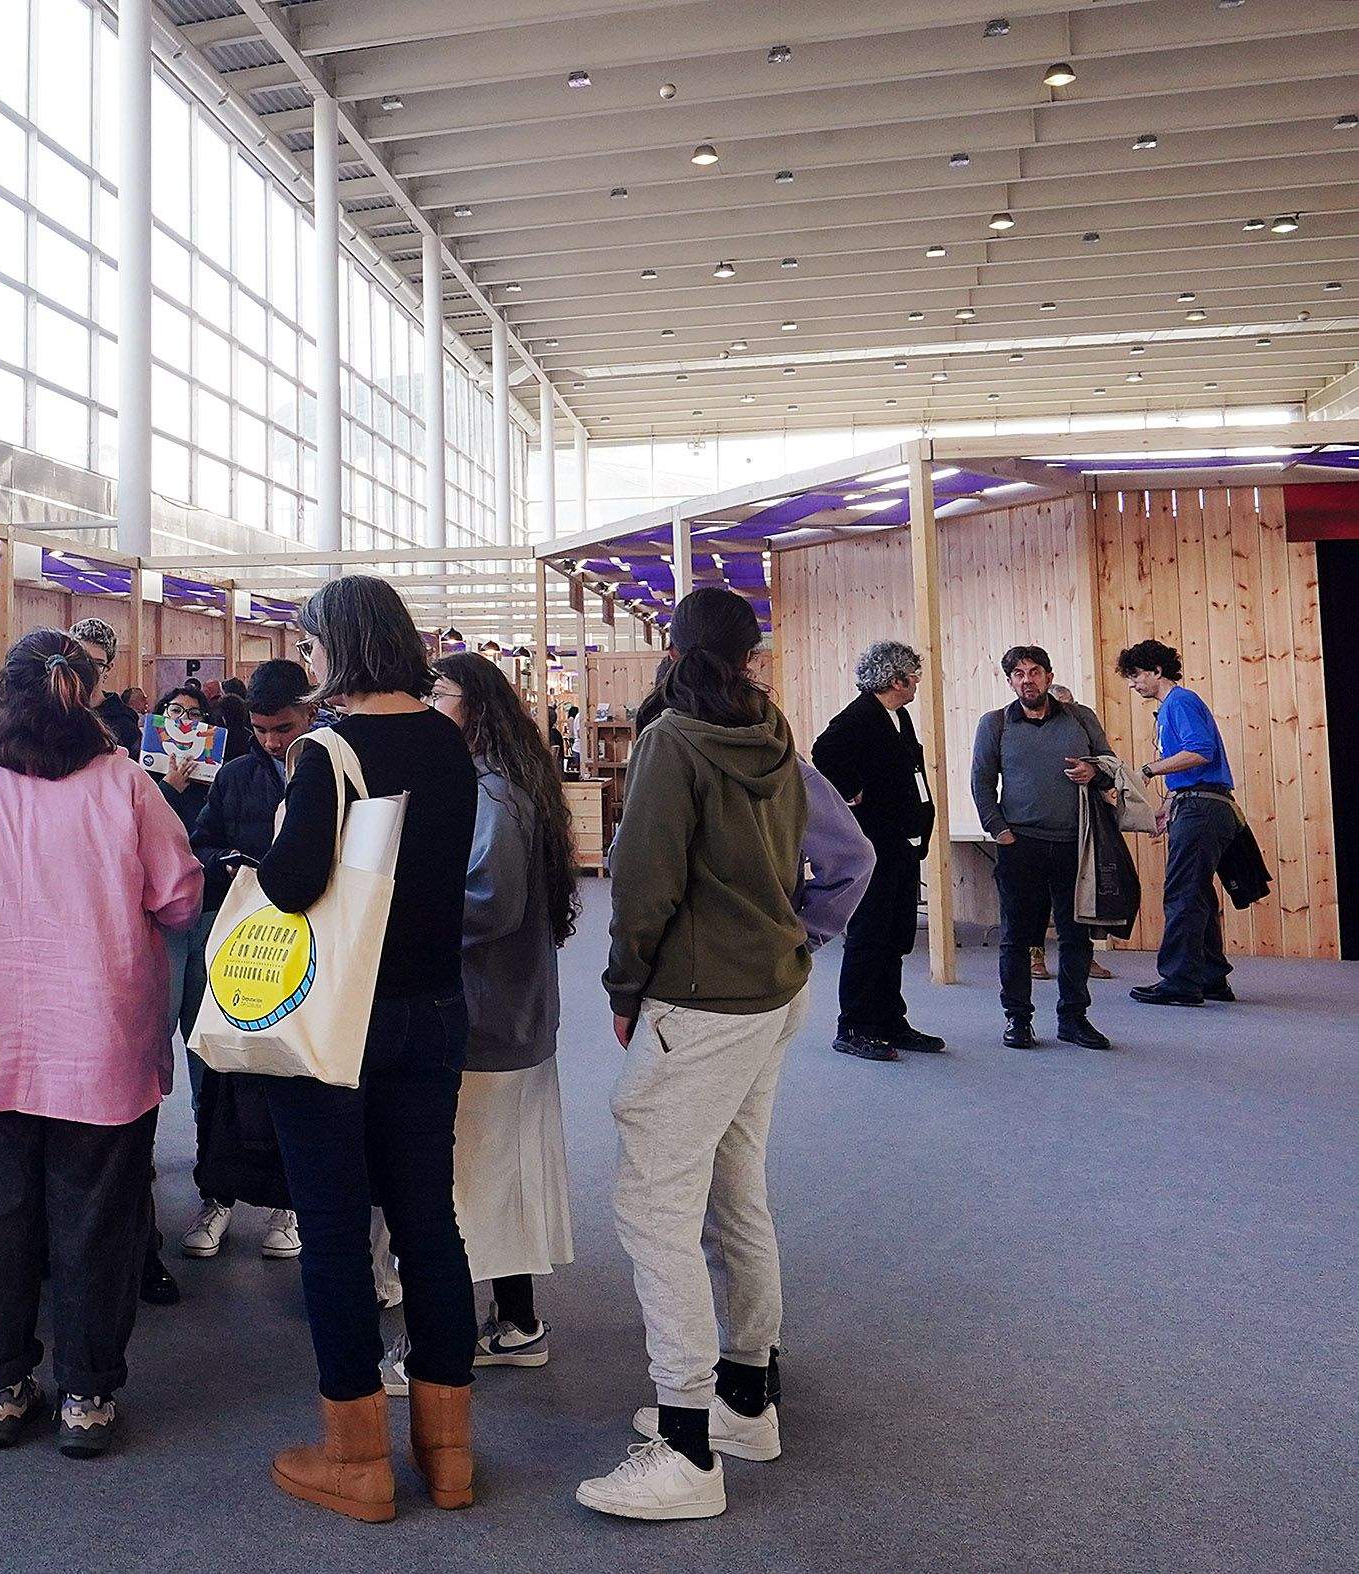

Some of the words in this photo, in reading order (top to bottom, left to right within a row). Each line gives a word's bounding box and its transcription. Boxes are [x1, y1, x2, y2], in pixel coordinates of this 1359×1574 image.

[236, 924, 246, 939] A
[247, 924, 297, 944] CULTURA
[238, 943, 250, 957] UN
[252, 945, 289, 962] DEREITO
